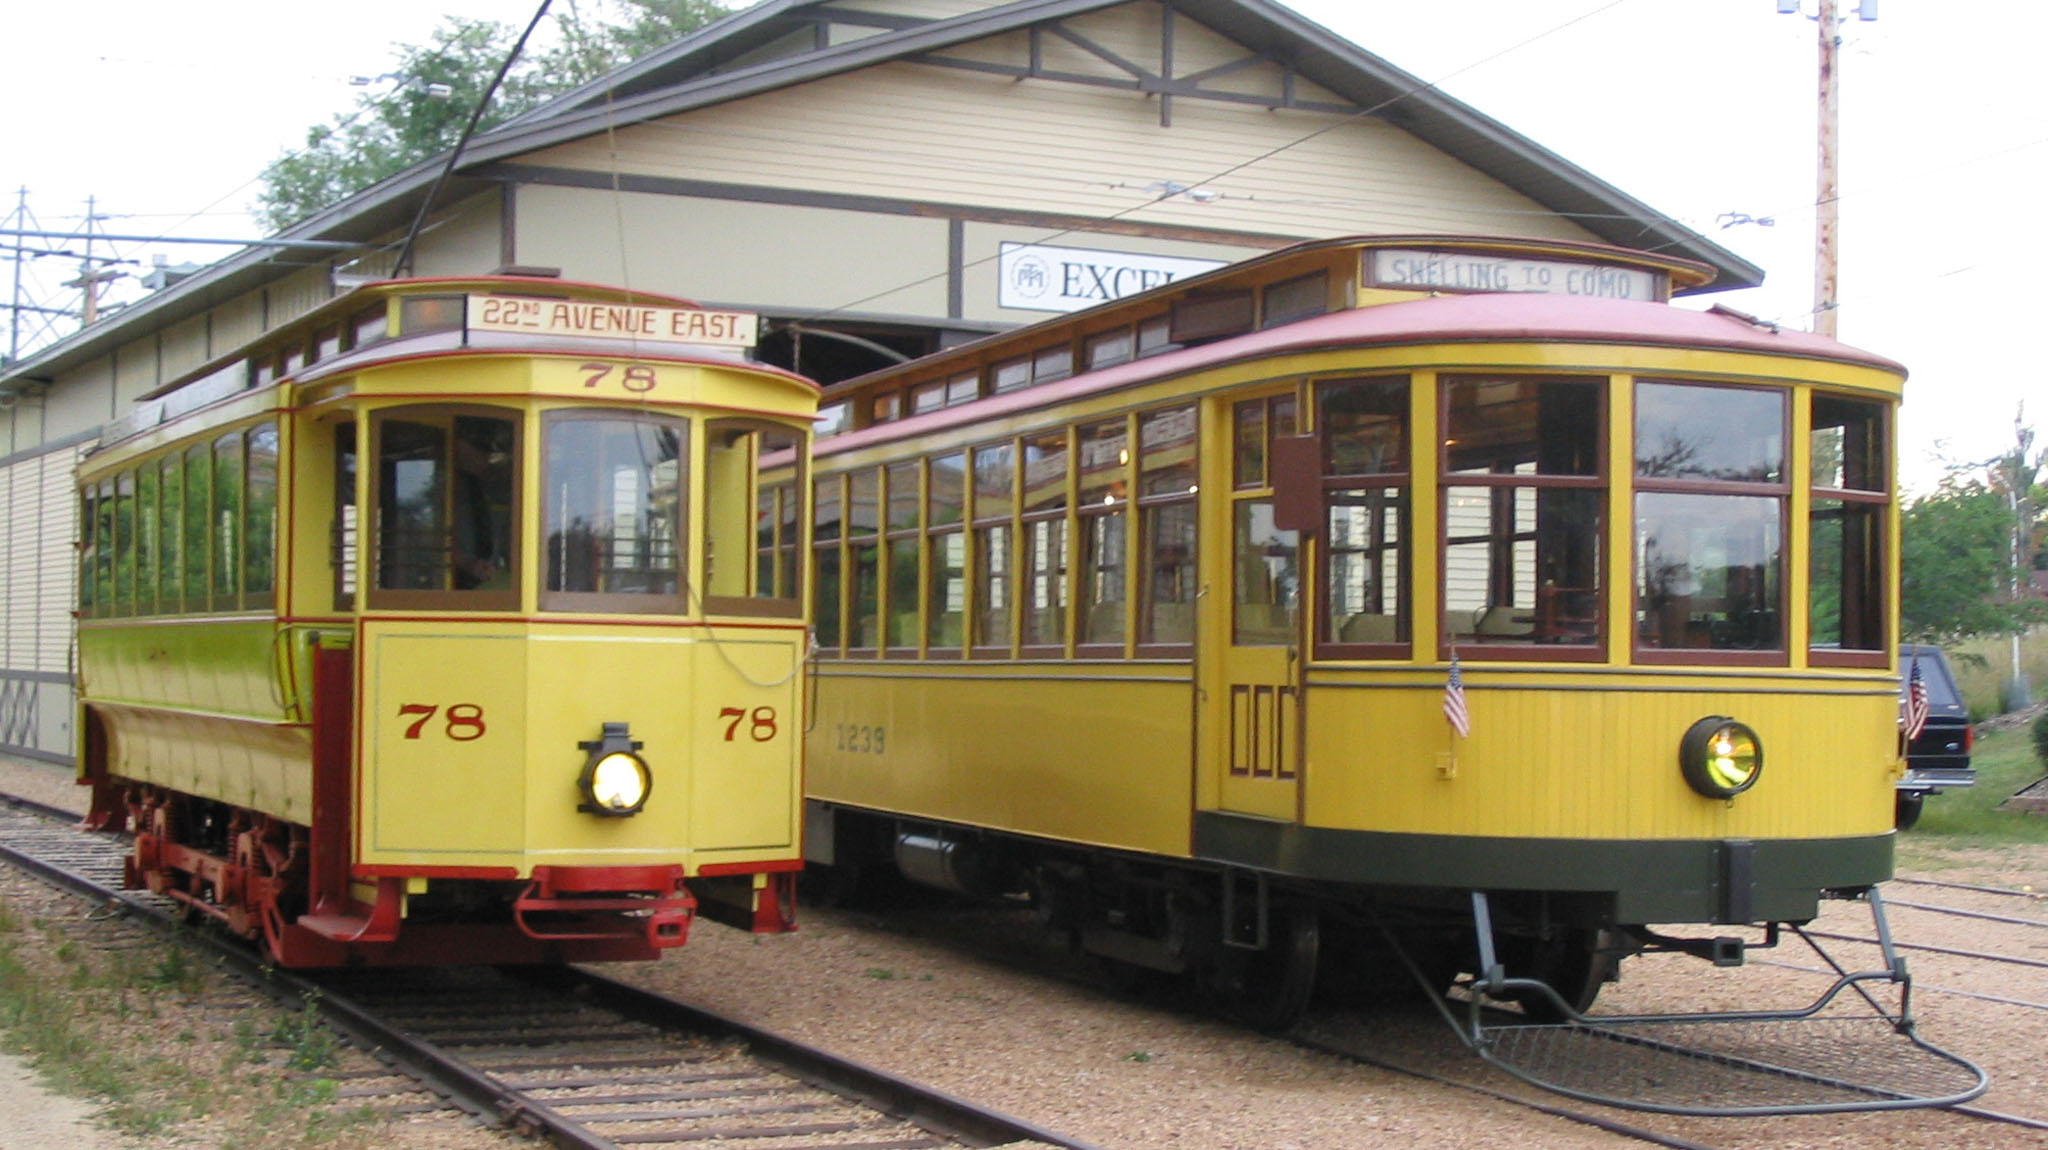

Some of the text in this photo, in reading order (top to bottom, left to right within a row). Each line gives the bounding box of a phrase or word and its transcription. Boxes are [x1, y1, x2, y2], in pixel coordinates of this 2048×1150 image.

[1391, 258, 1632, 299] SNELLING TO COMO
[549, 304, 657, 334] AVENUE
[671, 312, 747, 340] EAST.
[578, 363, 657, 393] 78
[398, 703, 487, 742] 78
[719, 706, 778, 742] 78
